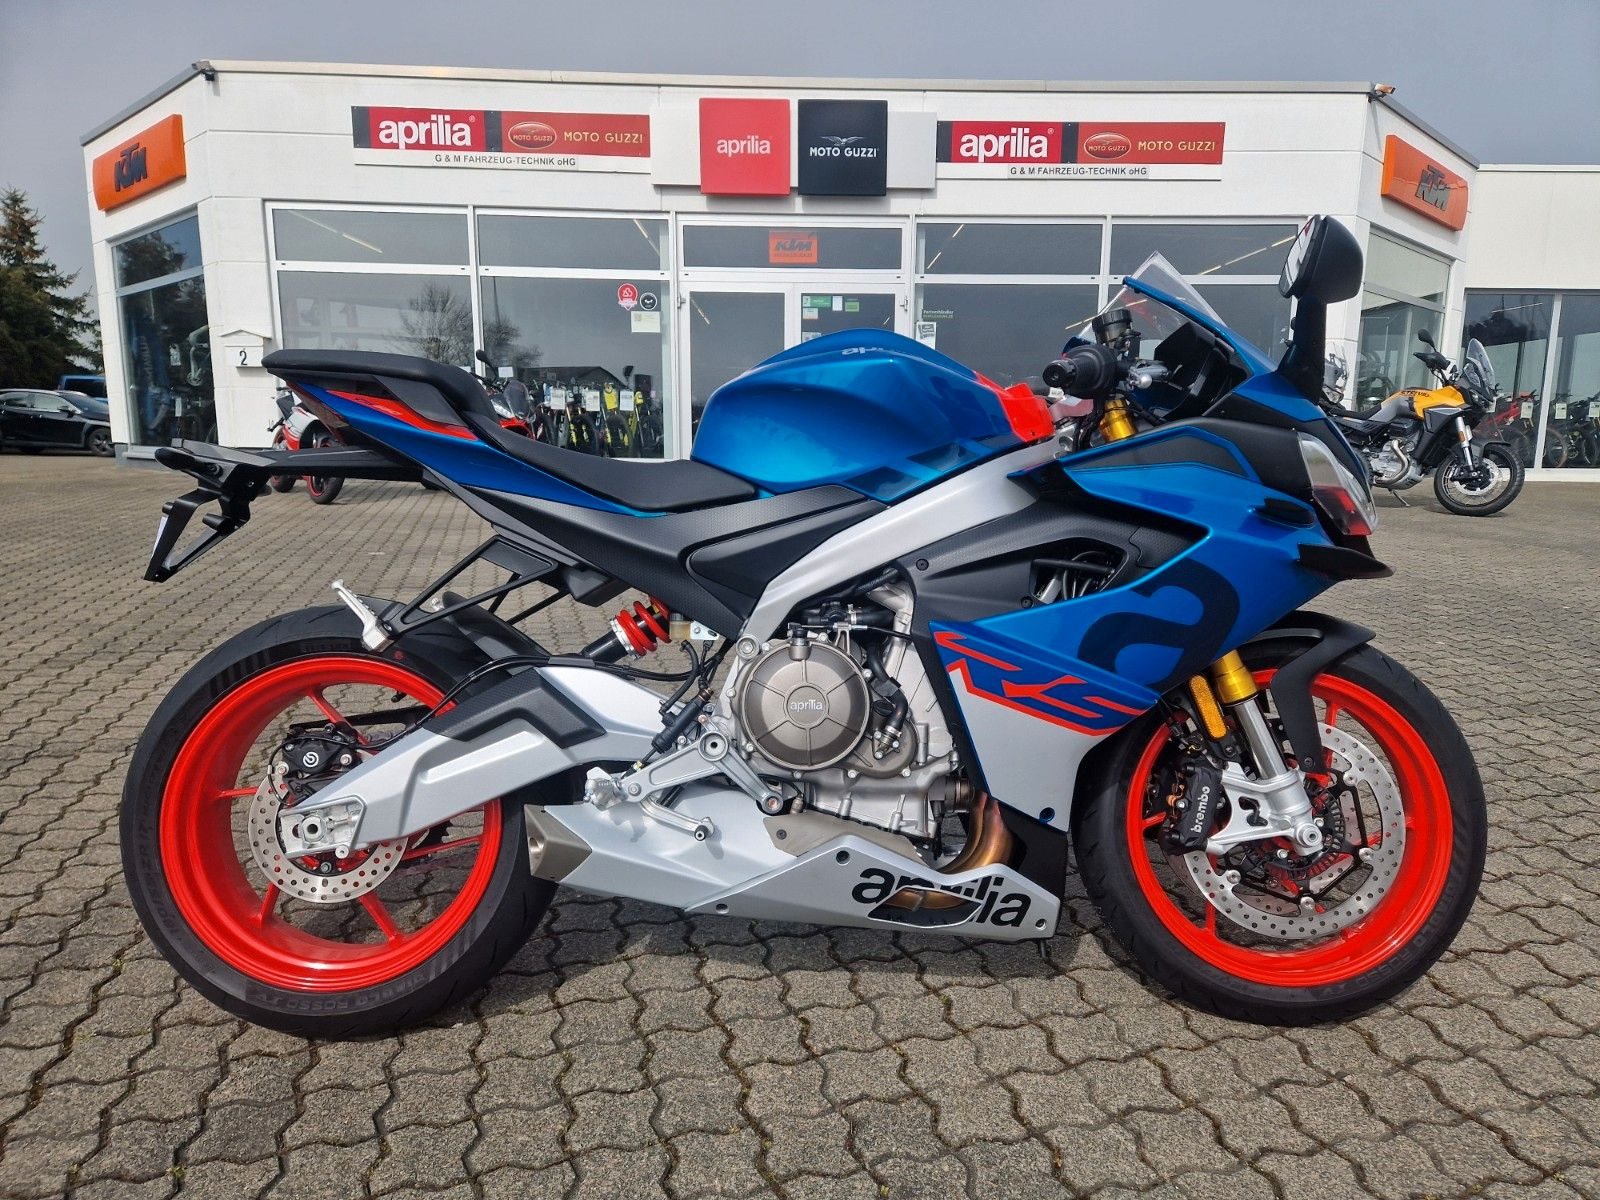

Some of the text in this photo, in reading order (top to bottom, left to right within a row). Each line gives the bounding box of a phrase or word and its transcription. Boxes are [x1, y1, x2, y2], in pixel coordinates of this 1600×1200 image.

[378, 114, 471, 150] aprilia
[512, 134, 553, 142] MOTO GUZZI
[563, 132, 643, 144] MOTO GUZZI
[716, 135, 771, 157] aprilia
[959, 127, 1048, 162] aprilia
[1138, 141, 1215, 151] MOTO GUZZI
[809, 147, 877, 158] MOTO GUZZI
[114, 142, 148, 192] KTM
[435, 154, 576, 166] G & M FAHRZEUG-TECHNIK oHG
[1010, 167, 1148, 176] G & M FAHRZEUG-TECHNIK oHG
[1415, 164, 1451, 212] KTM
[775, 239, 813, 251] KTM
[239, 350, 248, 366] 2
[790, 699, 823, 713] aprilia
[1190, 786, 1211, 833] brembo
